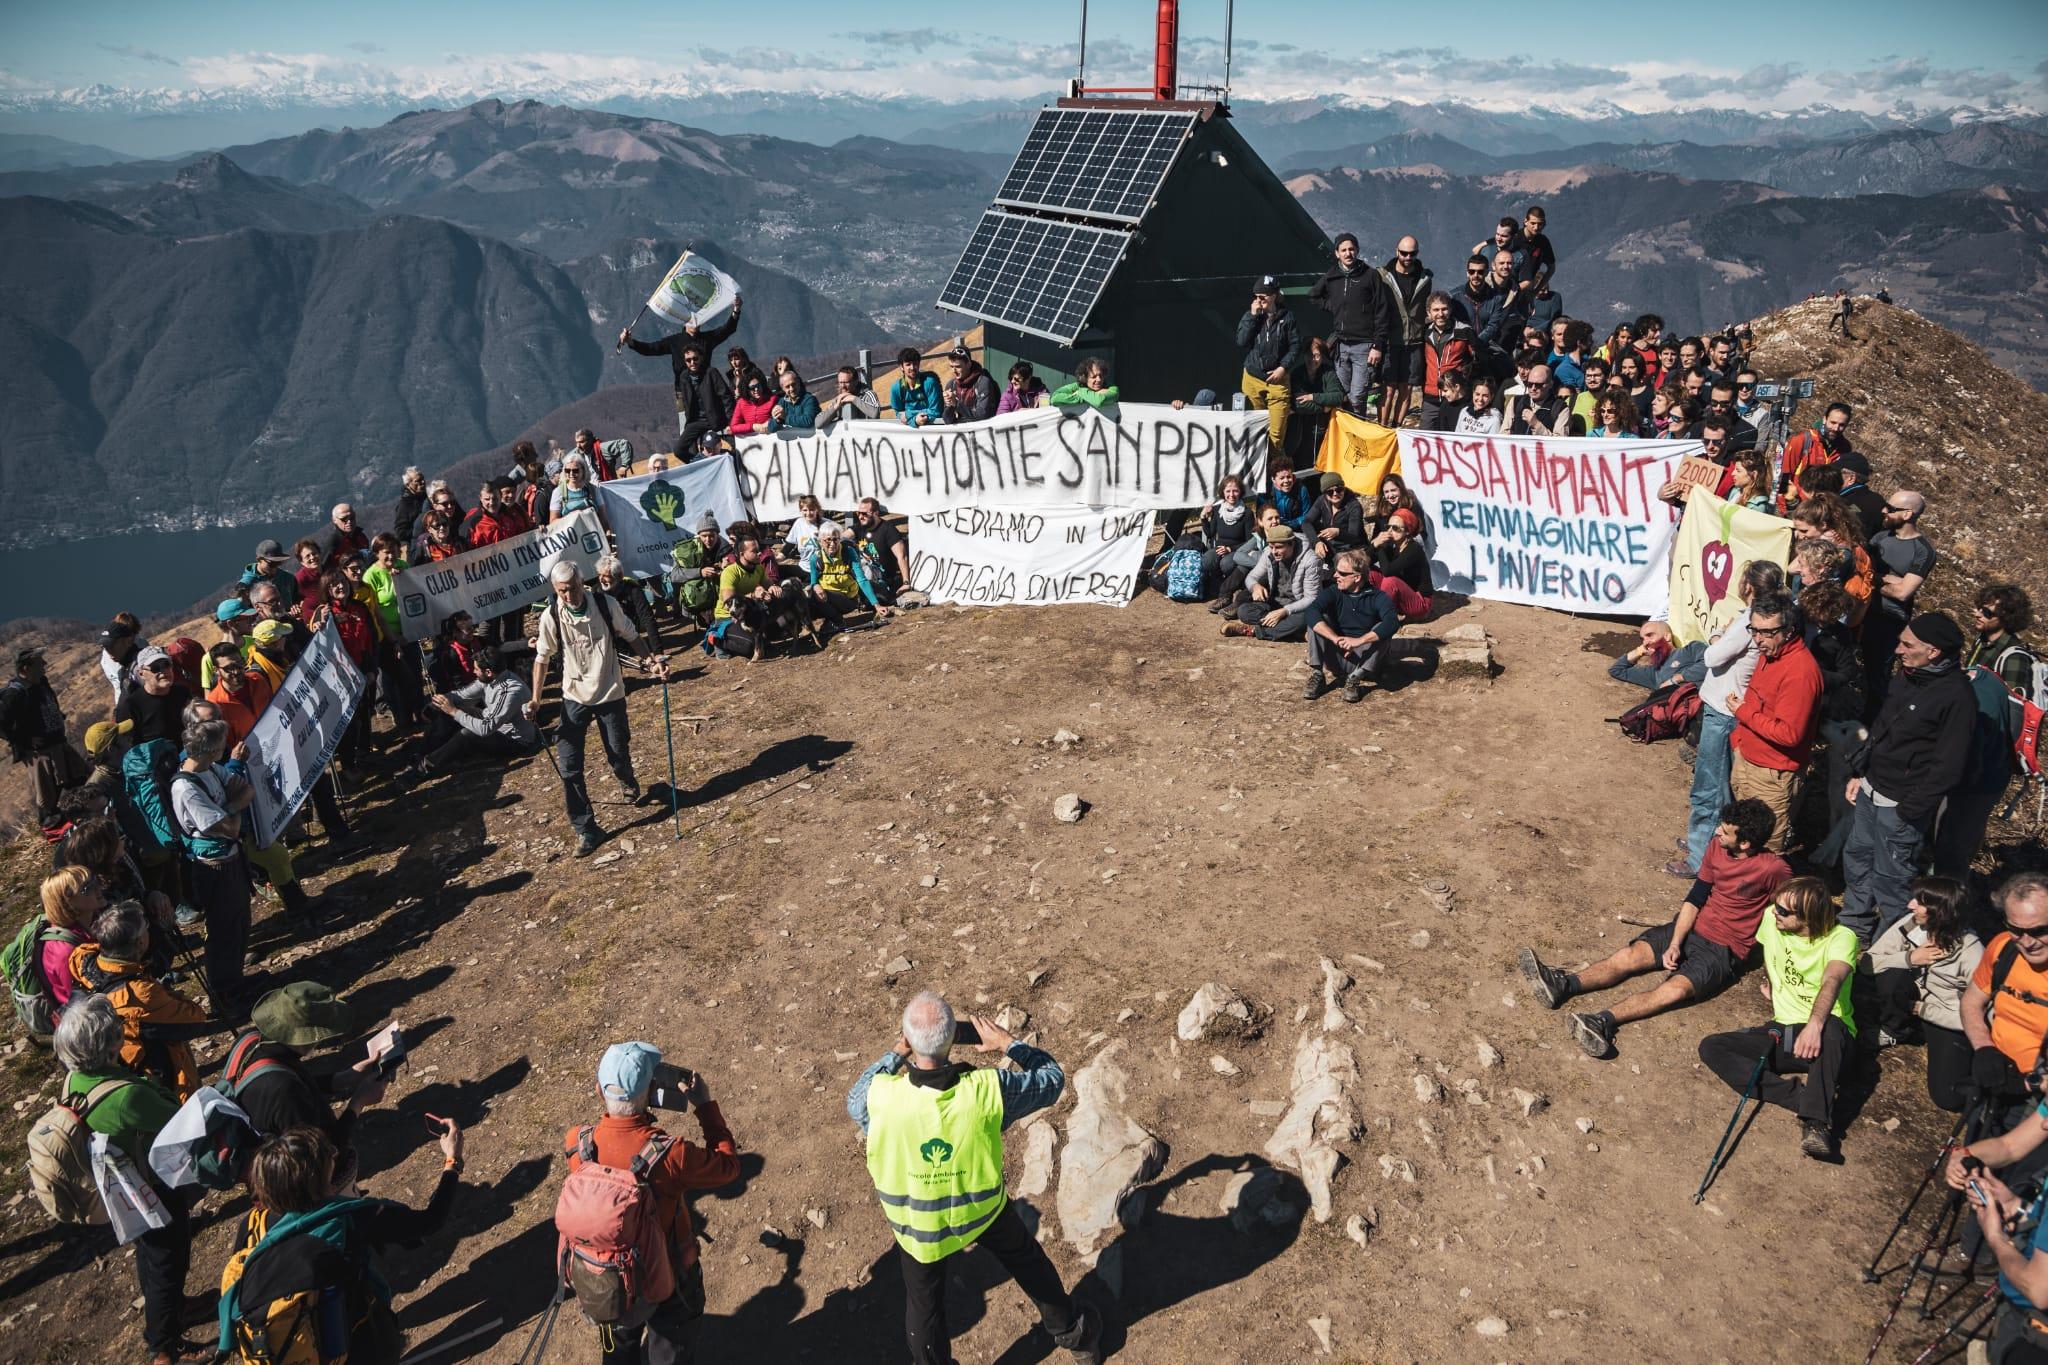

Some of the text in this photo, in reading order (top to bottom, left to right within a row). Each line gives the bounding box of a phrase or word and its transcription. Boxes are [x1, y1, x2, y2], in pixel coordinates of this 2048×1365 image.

[740, 436, 900, 505] SALVIAMO
[901, 448, 922, 478] IL
[922, 423, 1045, 495] MONTE
[1056, 409, 1143, 491] SAN
[1412, 436, 1511, 505] BASTA
[1680, 461, 1717, 487] 2000
[637, 540, 669, 554] circolo
[1066, 525, 1086, 544] IN
[1101, 511, 1147, 542] UNA
[1440, 500, 1648, 566] REIMMAGINARE
[425, 526, 578, 596] CLUB ALPINO ITALIANO
[1470, 543, 1626, 605] L'INVERNO
[473, 588, 508, 609] SEZIONE
[511, 583, 520, 595] DI
[1024, 570, 1132, 602] DIVERSA
